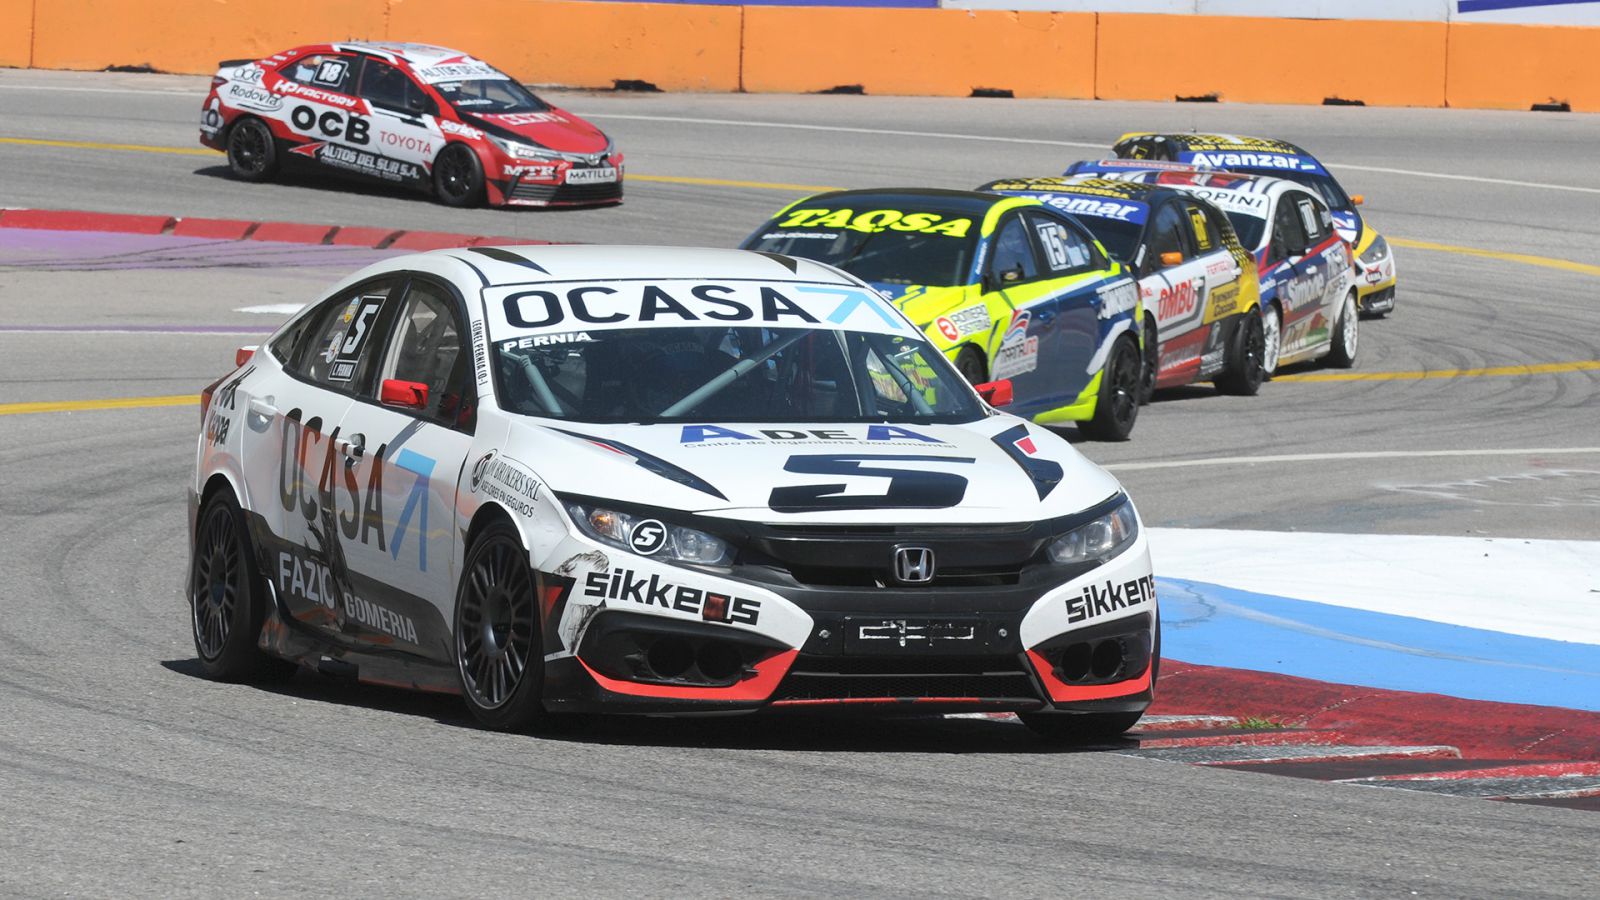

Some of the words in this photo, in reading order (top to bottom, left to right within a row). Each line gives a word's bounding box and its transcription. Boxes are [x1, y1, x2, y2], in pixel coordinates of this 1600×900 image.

[319, 62, 343, 82] 18
[291, 105, 371, 145] OCB
[379, 130, 432, 155] TOYOTA
[1191, 153, 1300, 169] Avanzar
[569, 170, 615, 180] MATILLA
[779, 208, 972, 238] TAQSA
[1040, 226, 1067, 265] 15
[503, 284, 820, 328] OCASA
[341, 304, 379, 354] 5
[503, 332, 593, 352] PERNIA
[474, 343, 486, 370] PERNIA
[522, 477, 542, 502] SRL
[768, 454, 976, 513] 5
[505, 494, 535, 518] SEGUROS
[344, 592, 419, 645] GOMERIA
